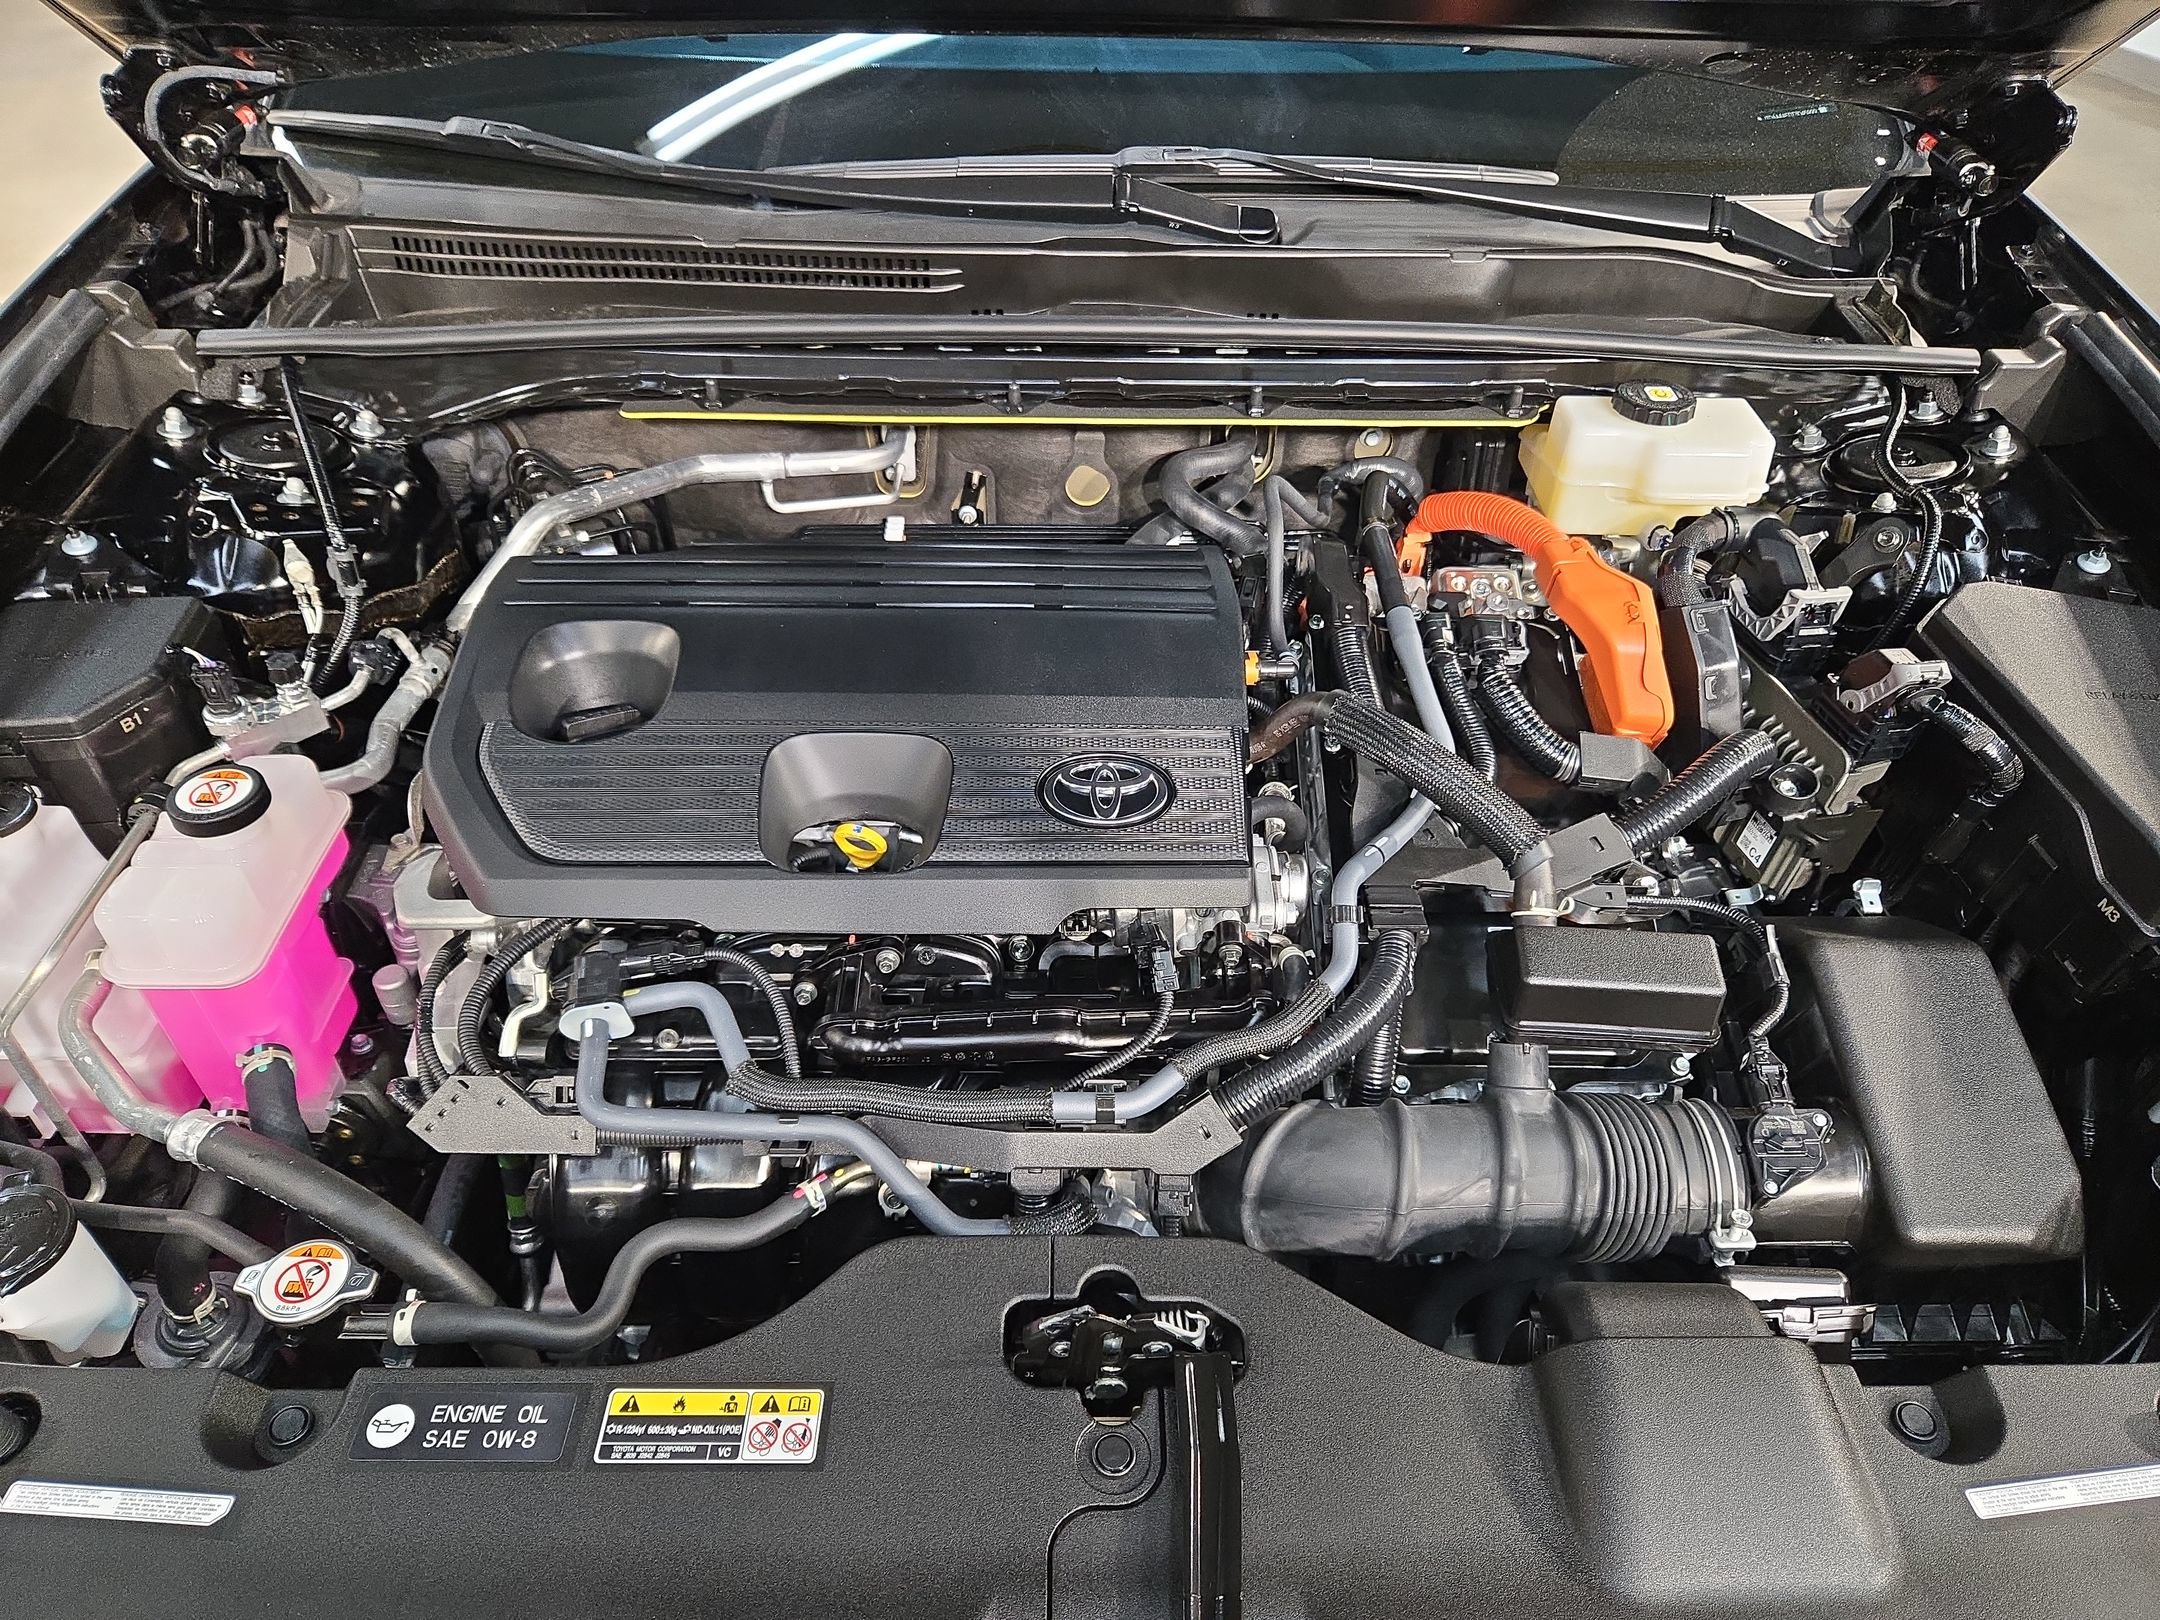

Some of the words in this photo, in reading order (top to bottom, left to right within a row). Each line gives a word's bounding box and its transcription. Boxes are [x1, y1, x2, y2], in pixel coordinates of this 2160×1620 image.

[119, 712, 143, 733] B1
[2097, 897, 2120, 922] M3
[430, 1404, 507, 1424] ENGINE
[517, 1405, 549, 1424] OIL
[422, 1429, 471, 1449] SAE
[615, 1424, 645, 1437] R-1234yf
[647, 1424, 678, 1437] 600±30g
[717, 1446, 732, 1458] VC
